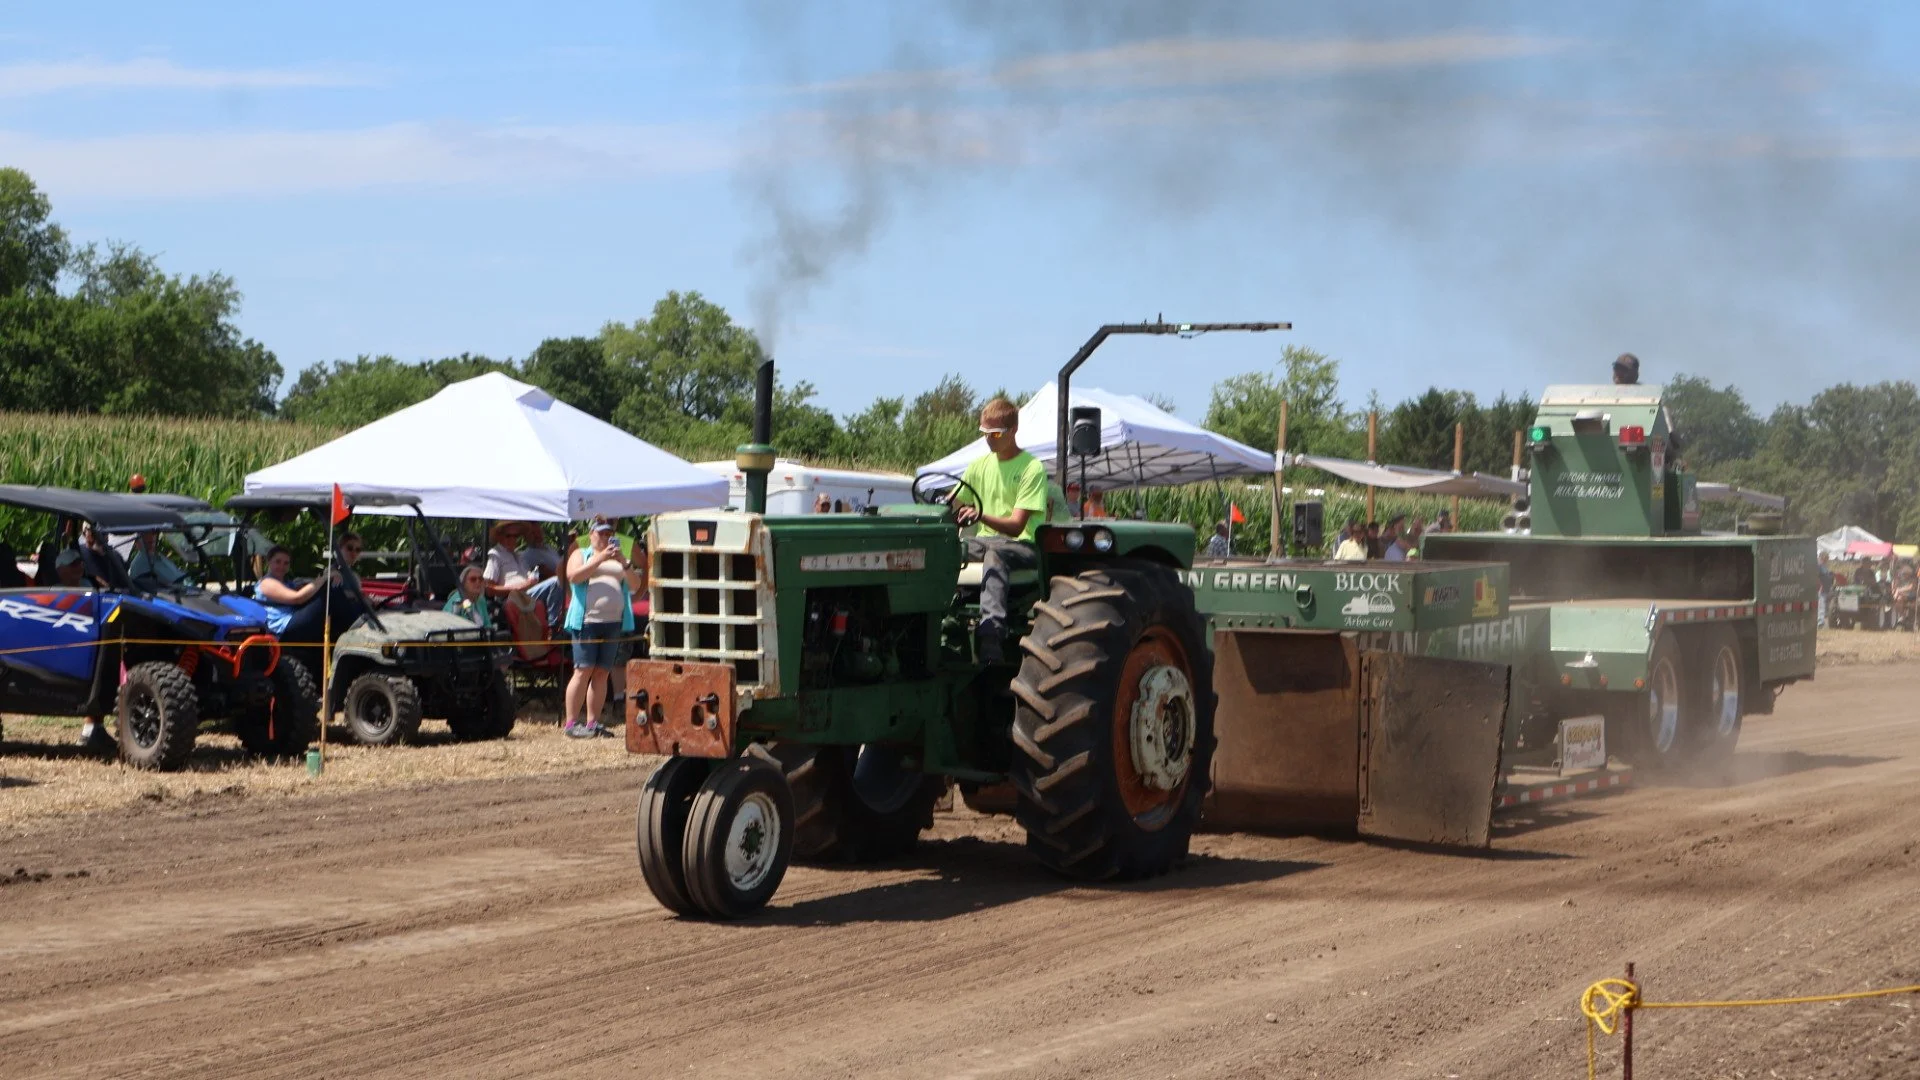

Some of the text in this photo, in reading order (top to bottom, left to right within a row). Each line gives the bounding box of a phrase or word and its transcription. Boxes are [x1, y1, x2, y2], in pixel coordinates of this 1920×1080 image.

[1213, 571, 1297, 593] GREEN
[1335, 572, 1403, 594] BLOCK
[0, 599, 94, 633] RZR
[1457, 615, 1527, 660] GREEN
